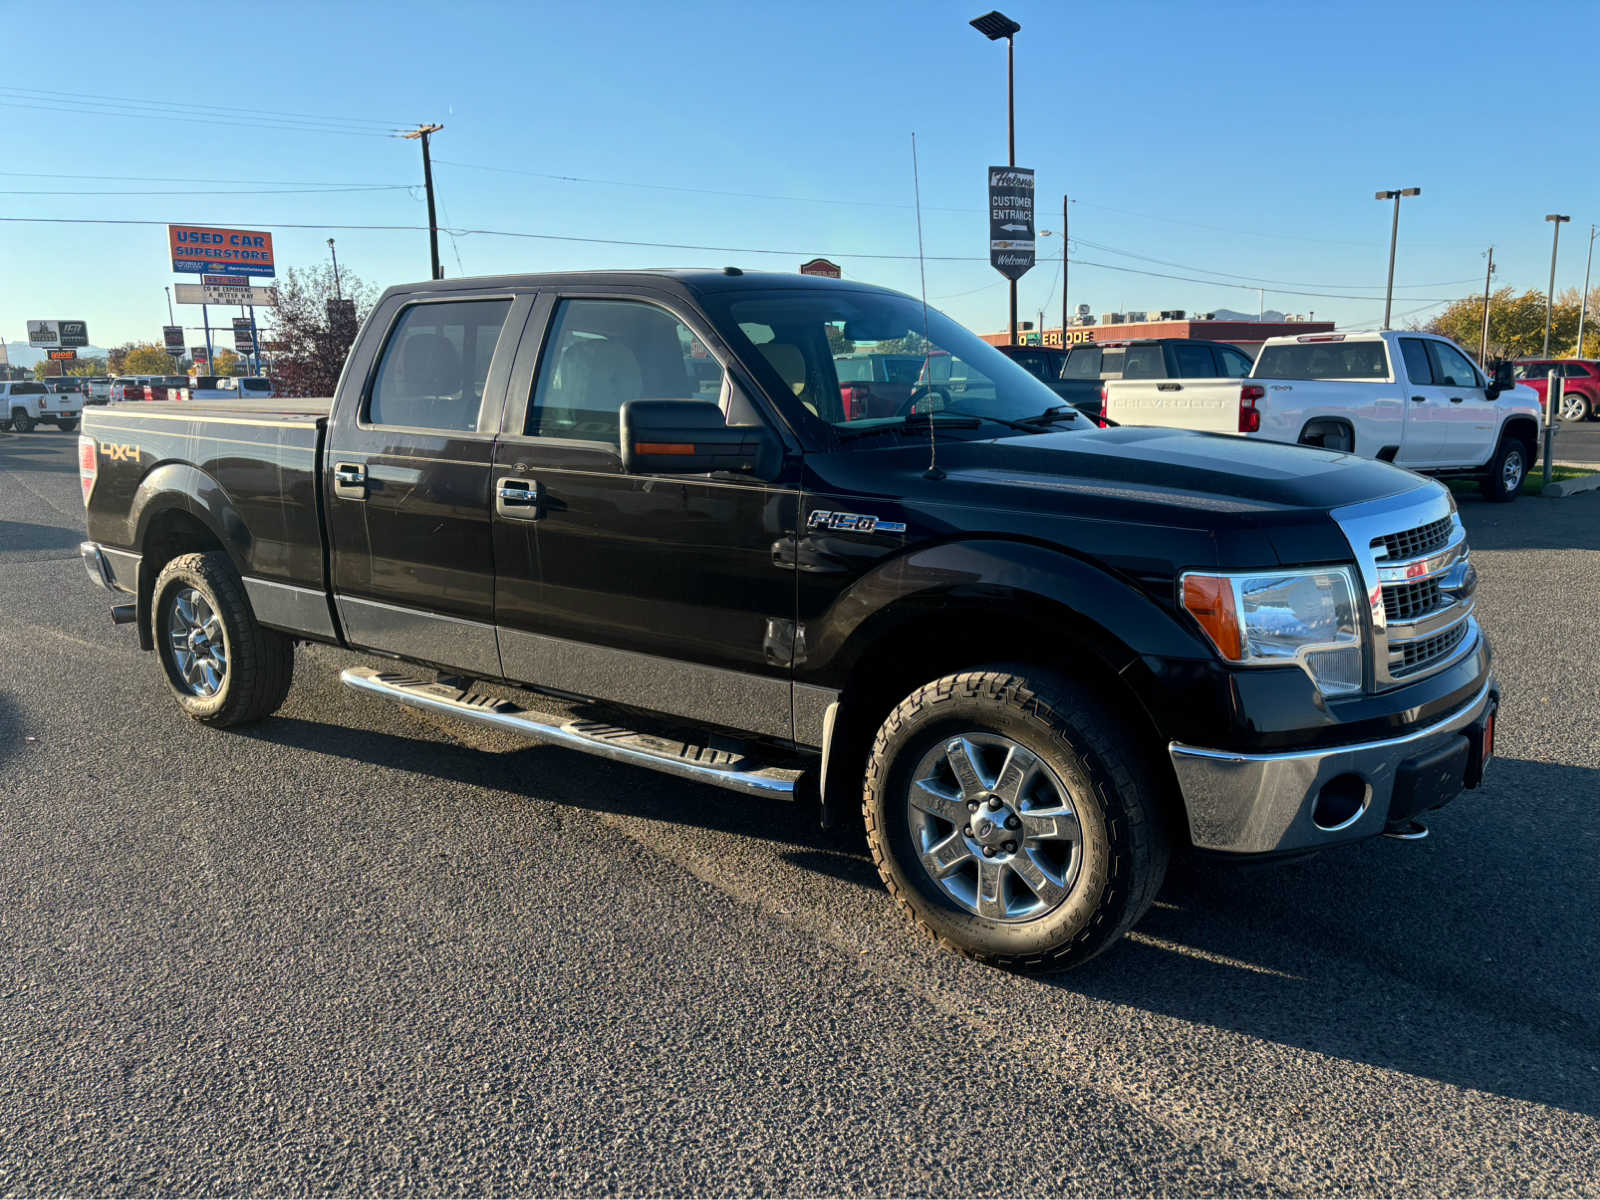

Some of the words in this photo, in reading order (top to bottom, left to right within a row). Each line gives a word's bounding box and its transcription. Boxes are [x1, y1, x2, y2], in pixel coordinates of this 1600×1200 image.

[992, 196, 1032, 208] CUSTOMER
[992, 209, 1032, 221] ENTRANCE
[176, 231, 224, 245] USED
[229, 234, 265, 248] CAR
[175, 246, 270, 261] SUPERSTORE
